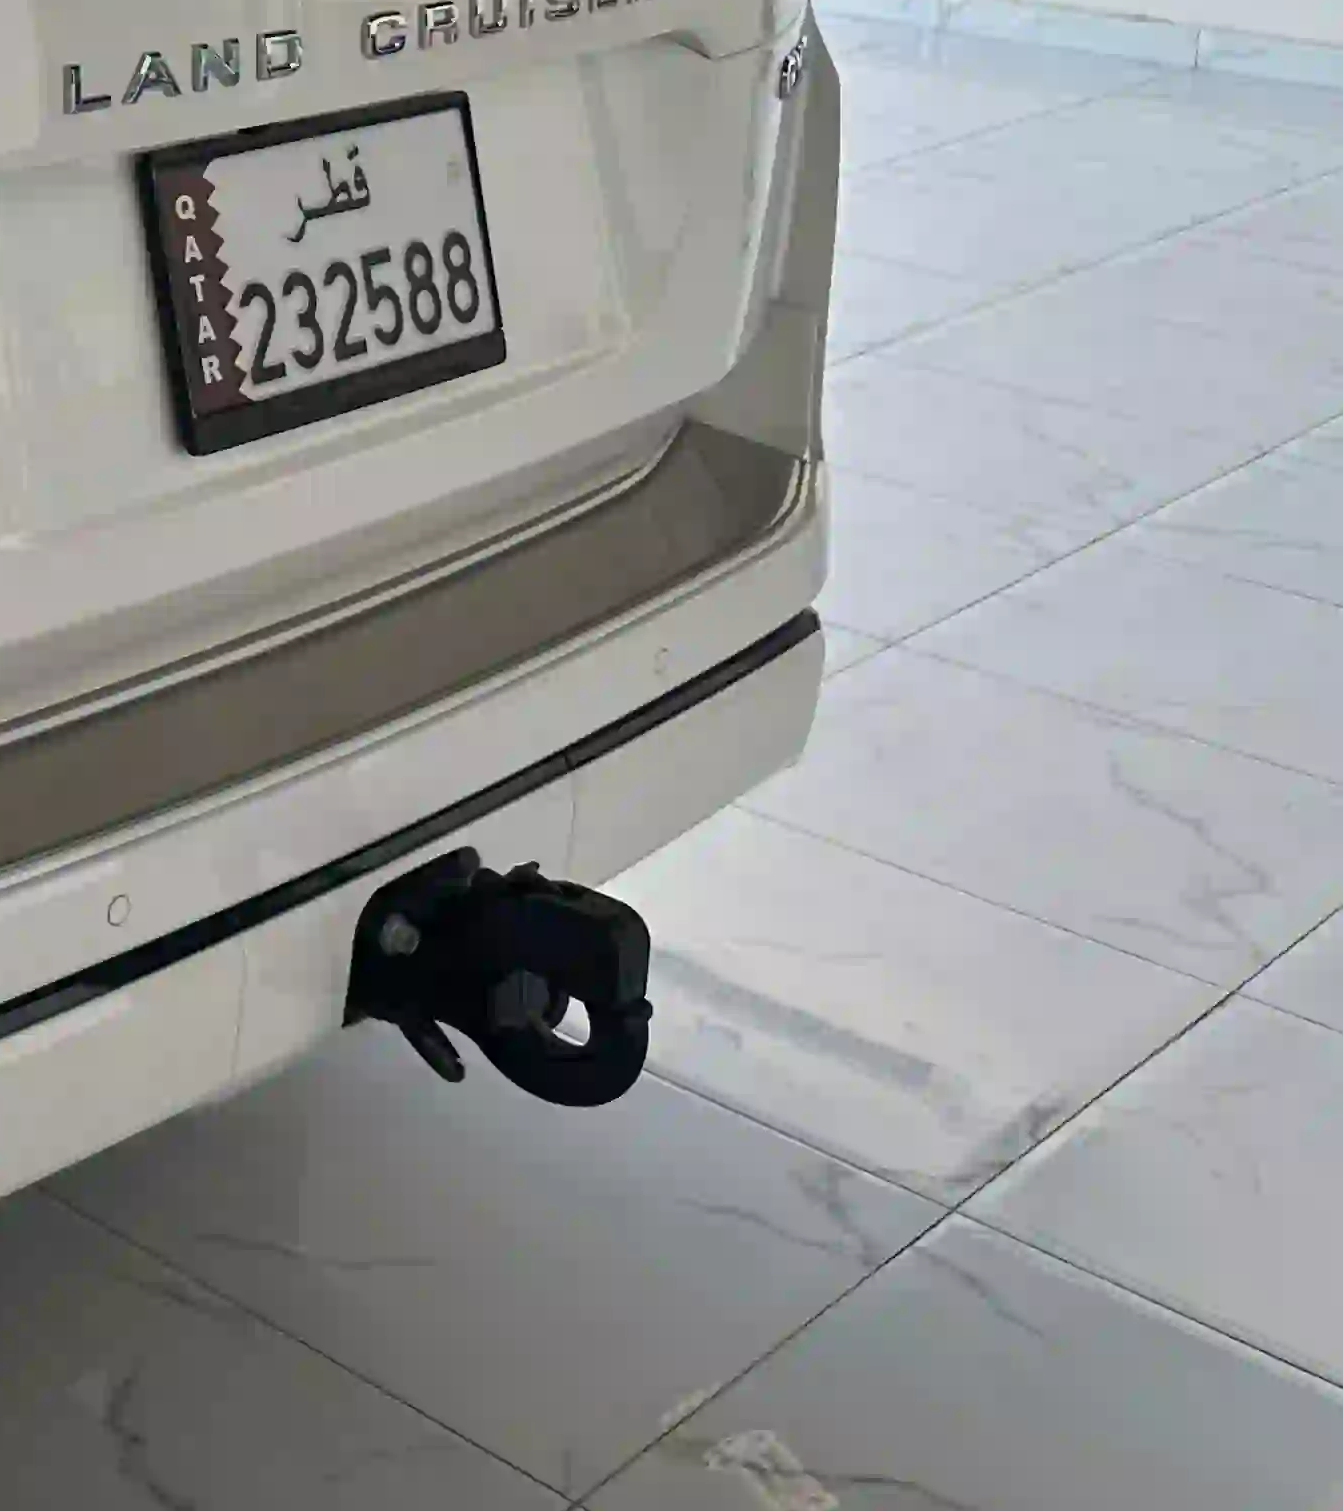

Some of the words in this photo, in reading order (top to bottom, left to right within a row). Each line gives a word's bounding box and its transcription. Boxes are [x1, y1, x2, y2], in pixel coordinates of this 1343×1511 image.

[62, 29, 304, 115] LAND
[286, 144, 371, 243] قطر
[175, 194, 223, 385] QATAR
[239, 228, 480, 384] 232588
